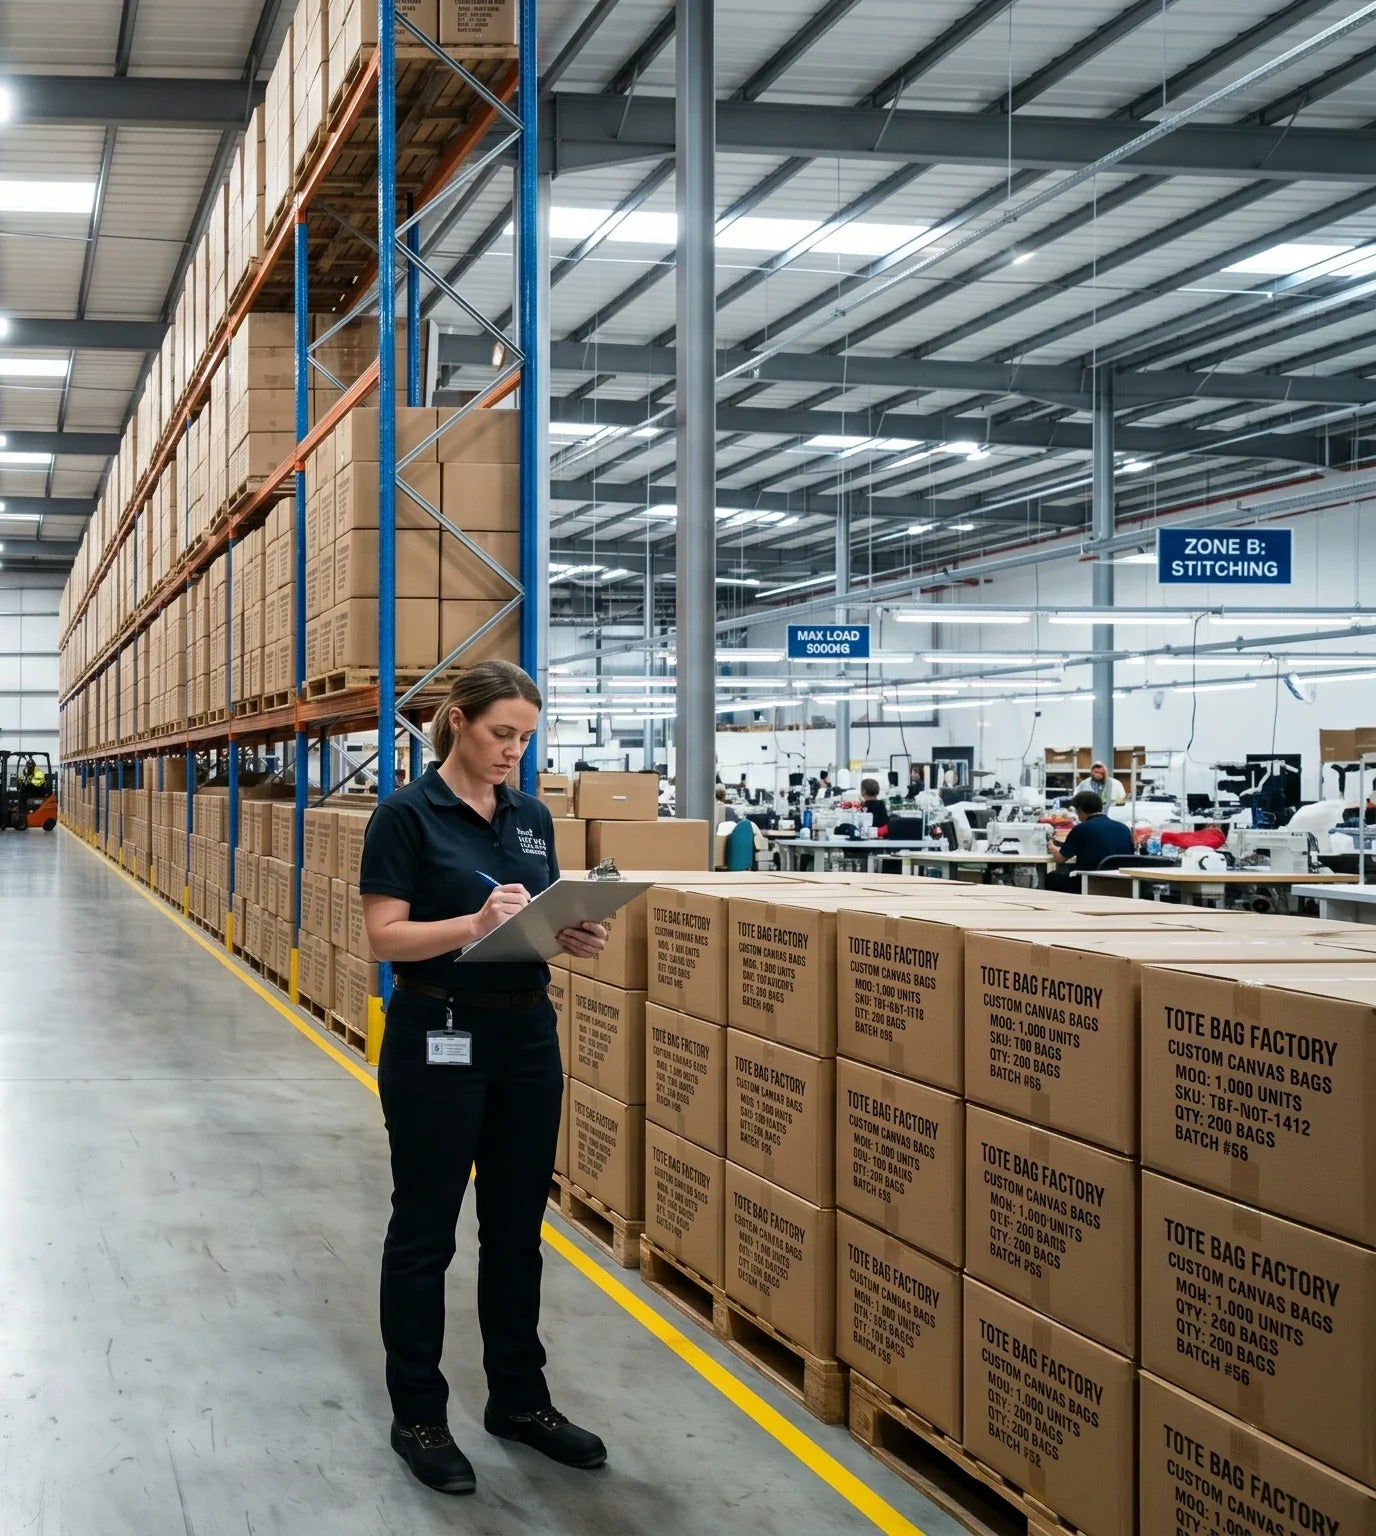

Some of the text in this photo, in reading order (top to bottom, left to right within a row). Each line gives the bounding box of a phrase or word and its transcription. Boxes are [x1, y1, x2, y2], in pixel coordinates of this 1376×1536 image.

[1171, 560, 1279, 577] STITCHING
[1184, 538, 1266, 555] ZONE B:
[797, 630, 860, 641] MAX LOAD
[737, 921, 809, 950] TOTE BAG FACTORY
[848, 936, 871, 958] TOTE
[893, 944, 940, 971] FACTORY
[980, 965, 1103, 1010] TOTE BAG FACTORY
[1164, 1006, 1338, 1067] TOTE BAG FACTORY
[1168, 1038, 1332, 1095] CUSTOM CANVAS BAGS
[847, 1089, 939, 1141] TOTE BAG FACTORY
[1175, 1084, 1206, 1106] SKU:
[1215, 1074, 1253, 1099] 1,000
[1257, 1085, 1302, 1112] UNITS
[1175, 1104, 1275, 1148] QTY: 200 BAGS
[1175, 1123, 1219, 1152] BATCH
[980, 1141, 1105, 1208] TOTE BAG FACTORY
[847, 1243, 871, 1271] TOTE
[893, 1268, 940, 1309] FACTORY
[1164, 1217, 1340, 1307] TOTE BAG FACTORY
[978, 1318, 1010, 1354] TOTE
[1012, 1337, 1038, 1370] BAG
[1176, 1317, 1276, 1376] QTY: 200 BAGS
[1176, 1336, 1220, 1372] BATCH
[1163, 1423, 1341, 1536] TOTE BAG FACTORY
